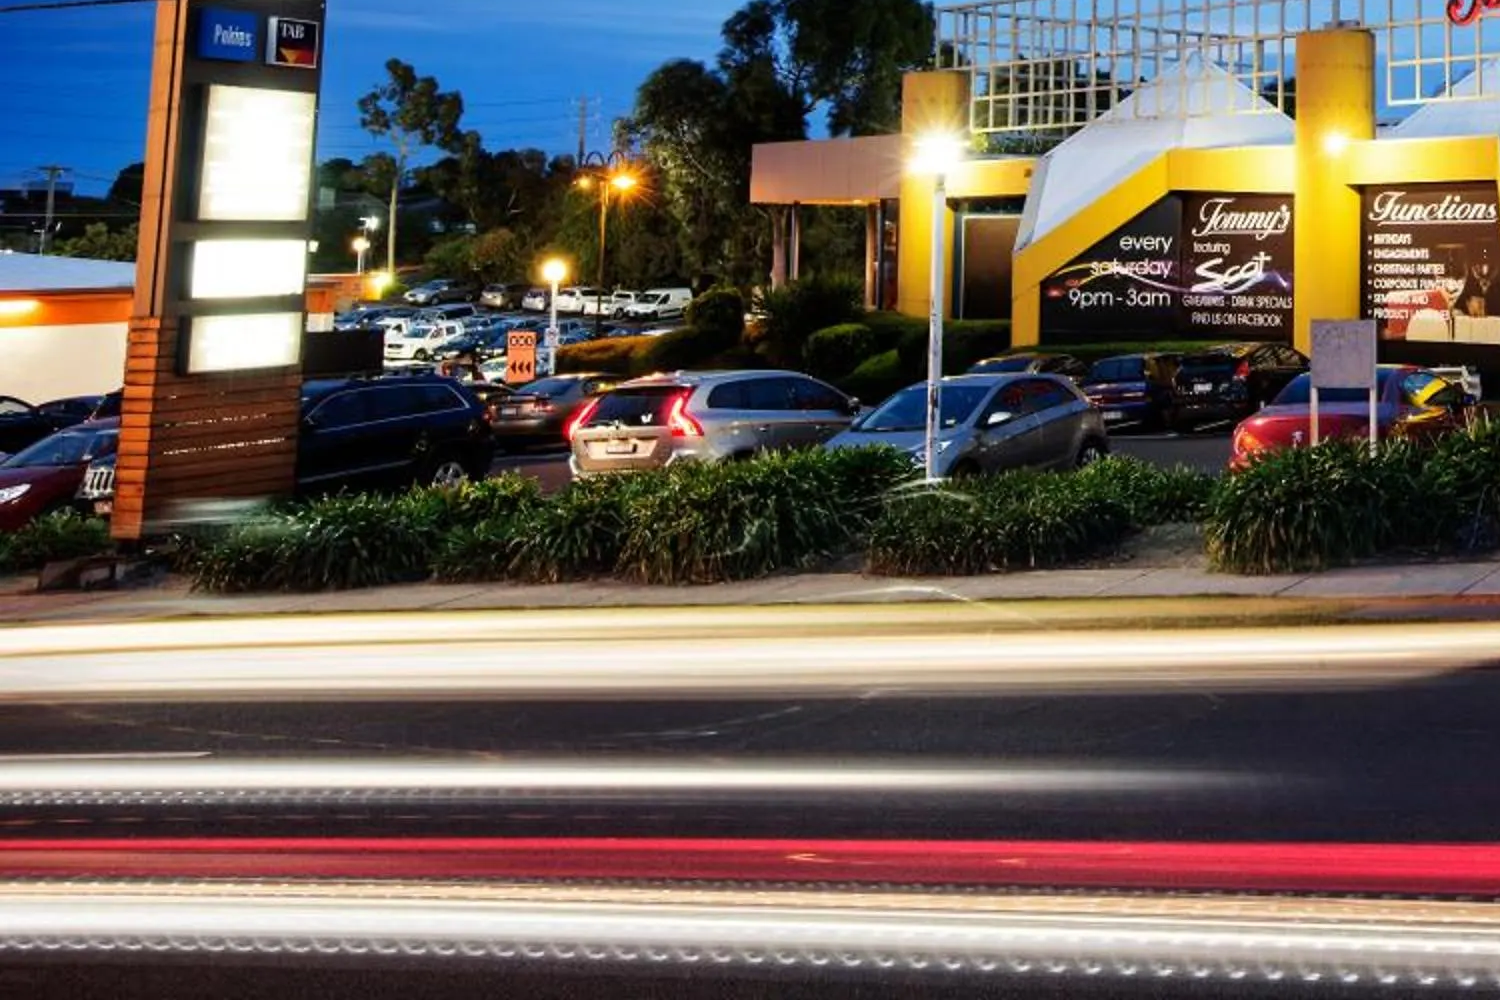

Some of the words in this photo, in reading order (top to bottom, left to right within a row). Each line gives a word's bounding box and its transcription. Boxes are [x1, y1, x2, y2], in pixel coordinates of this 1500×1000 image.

[214, 24, 252, 47] Pokies
[280, 22, 304, 38] TAB
[1192, 198, 1291, 240] Tommy's
[1368, 191, 1499, 227] Functions
[1119, 234, 1173, 252] every
[1193, 242, 1231, 255] featuring
[1090, 258, 1173, 278] saturday
[1068, 289, 1114, 309] 9pm
[1127, 289, 1171, 307] 3am
